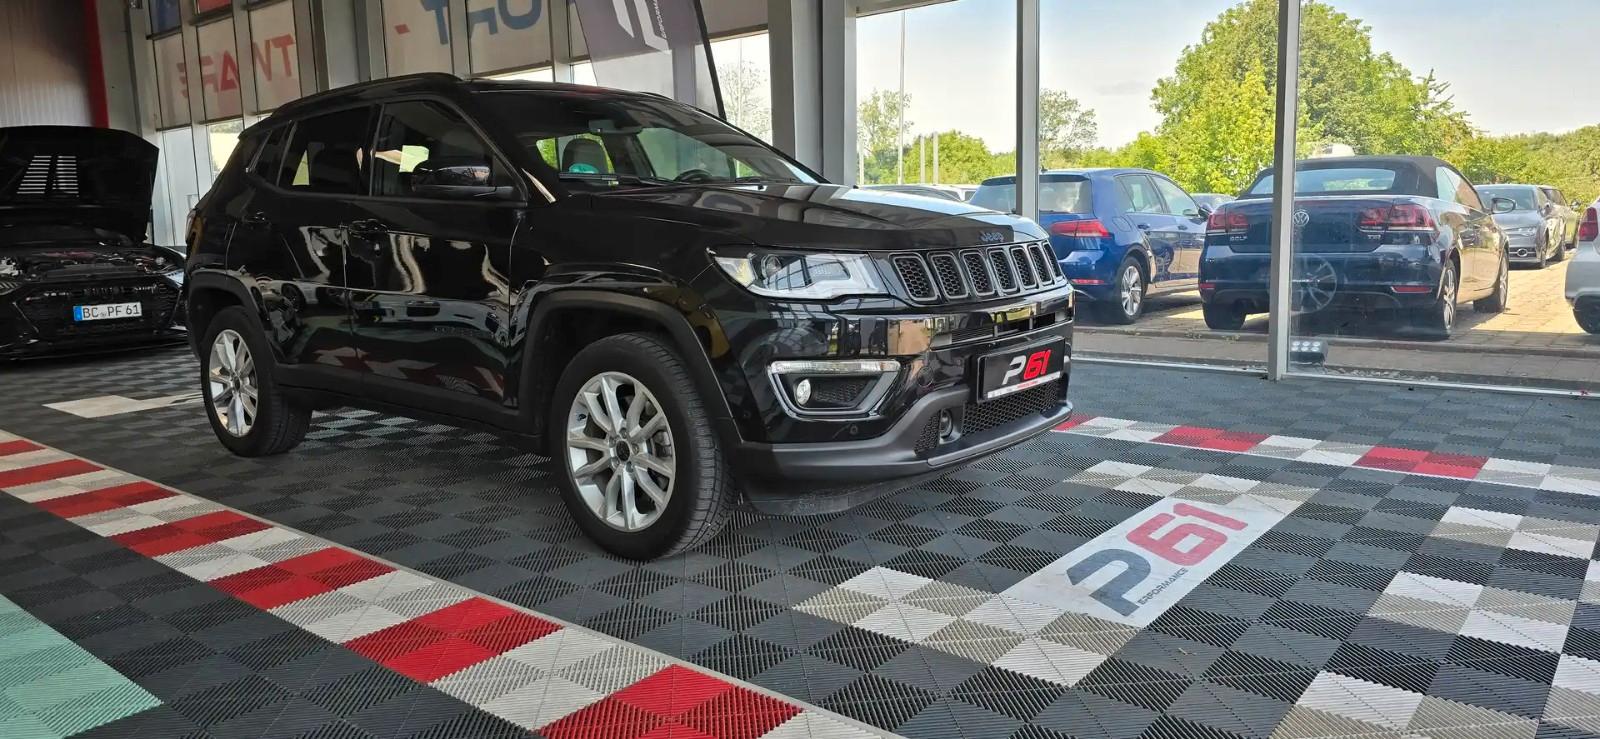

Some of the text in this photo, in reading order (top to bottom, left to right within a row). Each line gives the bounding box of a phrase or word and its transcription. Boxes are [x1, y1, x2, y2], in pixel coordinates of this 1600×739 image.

[82, 304, 140, 319] BC PF 61
[1001, 349, 1052, 385] P61
[1066, 502, 1248, 617] P61
